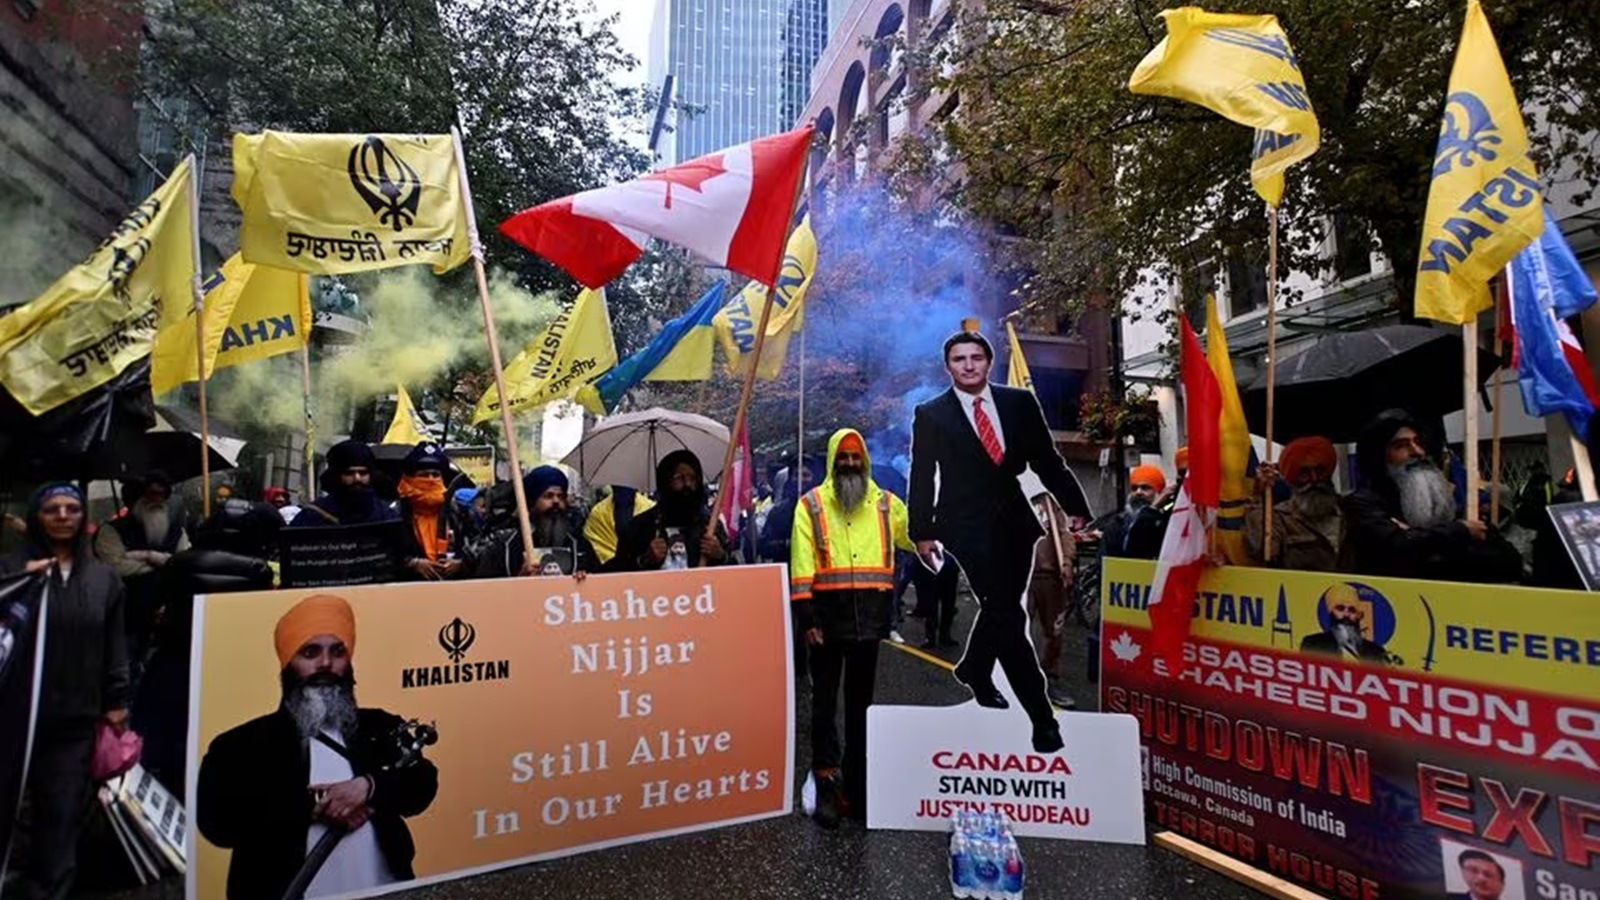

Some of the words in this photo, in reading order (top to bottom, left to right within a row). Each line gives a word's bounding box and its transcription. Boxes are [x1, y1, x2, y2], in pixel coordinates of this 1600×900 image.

[543, 584, 716, 626] Shaheed
[401, 660, 510, 688] KHALISTAN
[570, 636, 695, 676] Nijjar
[617, 689, 653, 719] Is
[1182, 641, 1530, 728] SSASSINATION
[511, 740, 609, 783] Still
[627, 728, 732, 766] Alive
[932, 752, 1072, 775] CANADA
[1107, 685, 1372, 805] SHUTDOWN
[473, 808, 520, 840] In
[541, 792, 623, 826] Our
[639, 768, 770, 810] Hearts
[939, 776, 1007, 796] STAND
[1011, 778, 1066, 799] WITH
[1152, 754, 1181, 783] High
[1185, 765, 1272, 814] Commission
[1278, 798, 1295, 821] of
[1300, 803, 1347, 839] India
[990, 802, 1090, 826] TRUDEAU
[1205, 797, 1254, 827] Canada
